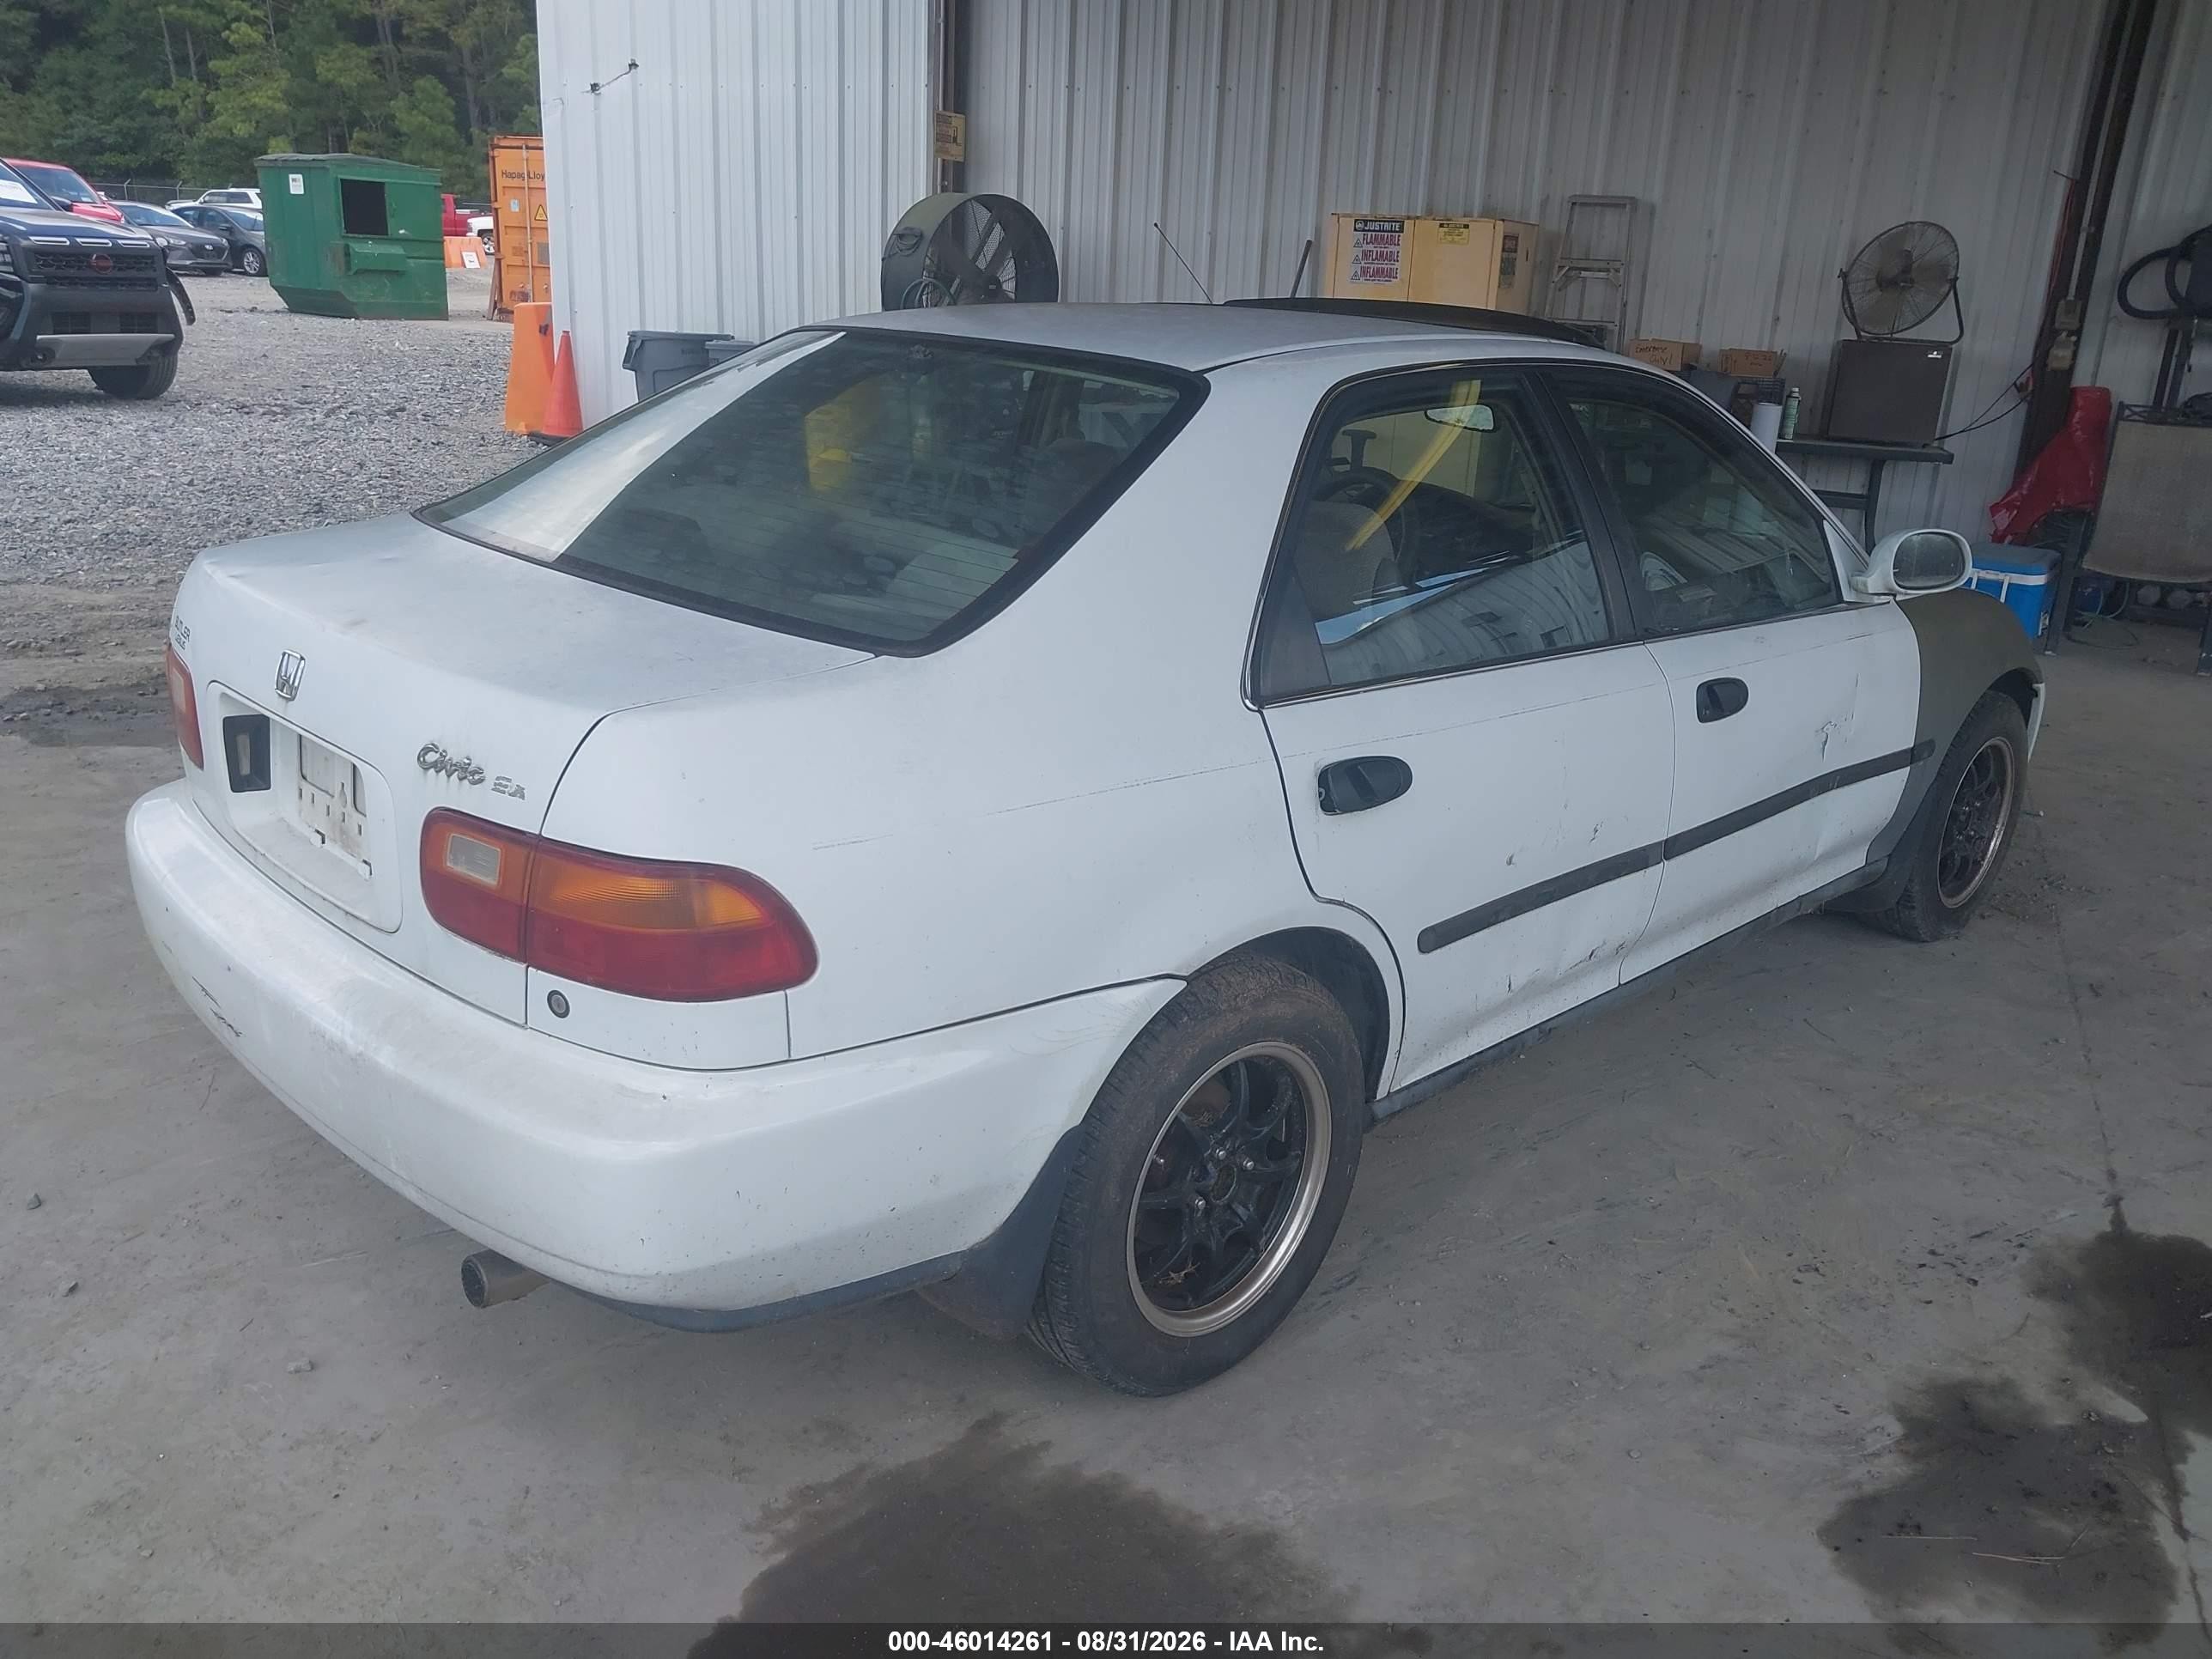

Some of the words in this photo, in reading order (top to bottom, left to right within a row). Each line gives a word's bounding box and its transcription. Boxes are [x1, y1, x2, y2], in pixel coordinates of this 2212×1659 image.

[1364, 221, 1401, 231] JUSTRITE
[1362, 233, 1401, 246] FLAMMABLE
[417, 742, 486, 786] Civic
